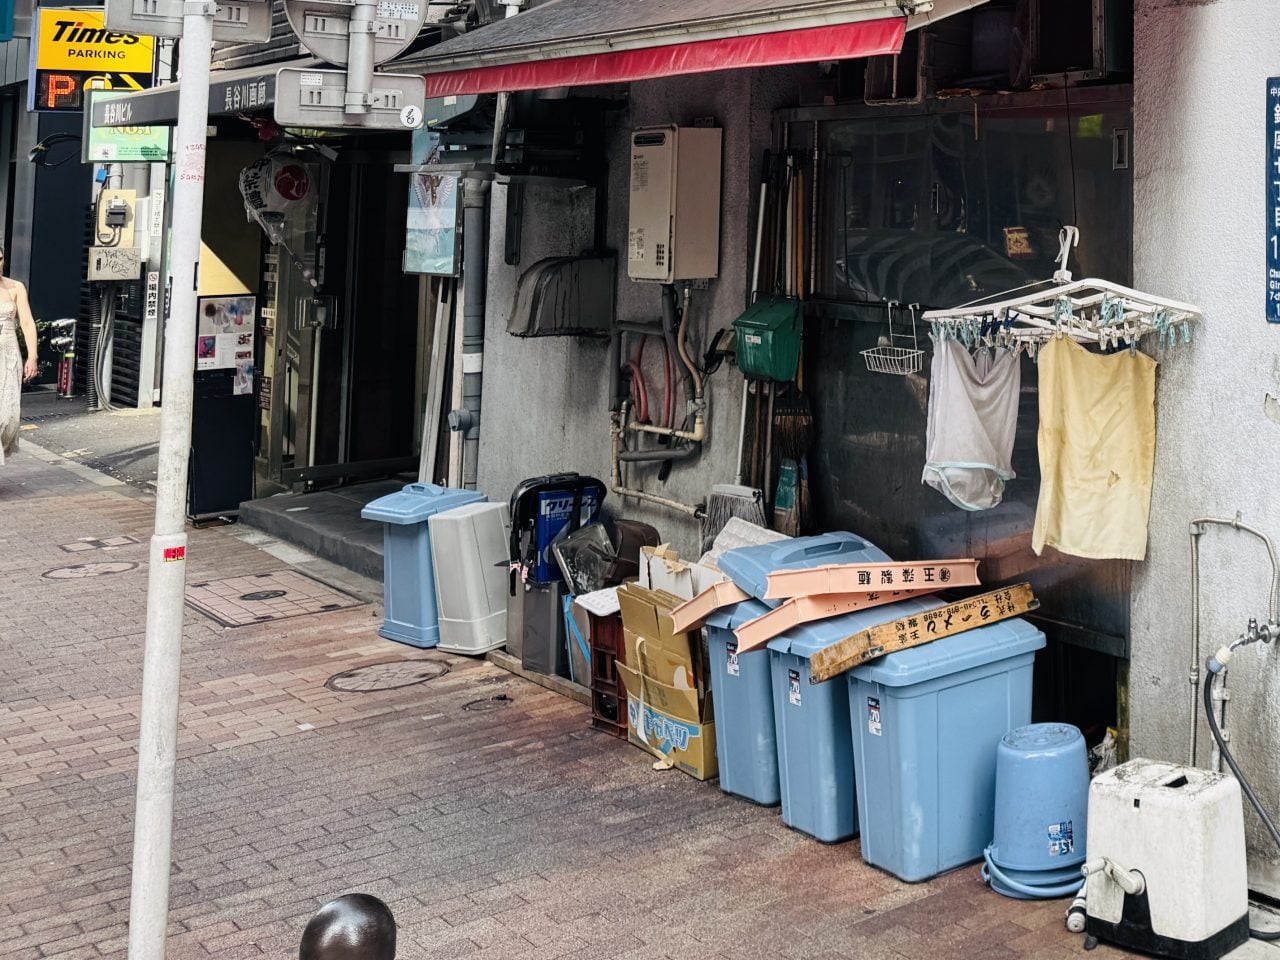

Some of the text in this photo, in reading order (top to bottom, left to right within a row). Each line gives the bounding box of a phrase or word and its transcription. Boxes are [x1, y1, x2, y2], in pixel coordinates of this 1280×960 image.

[52, 20, 140, 46] Times
[67, 48, 127, 60] PARKING
[47, 74, 76, 108] P
[224, 82, 267, 111] 長谷川画廊
[103, 103, 133, 125] 長谷川ビル
